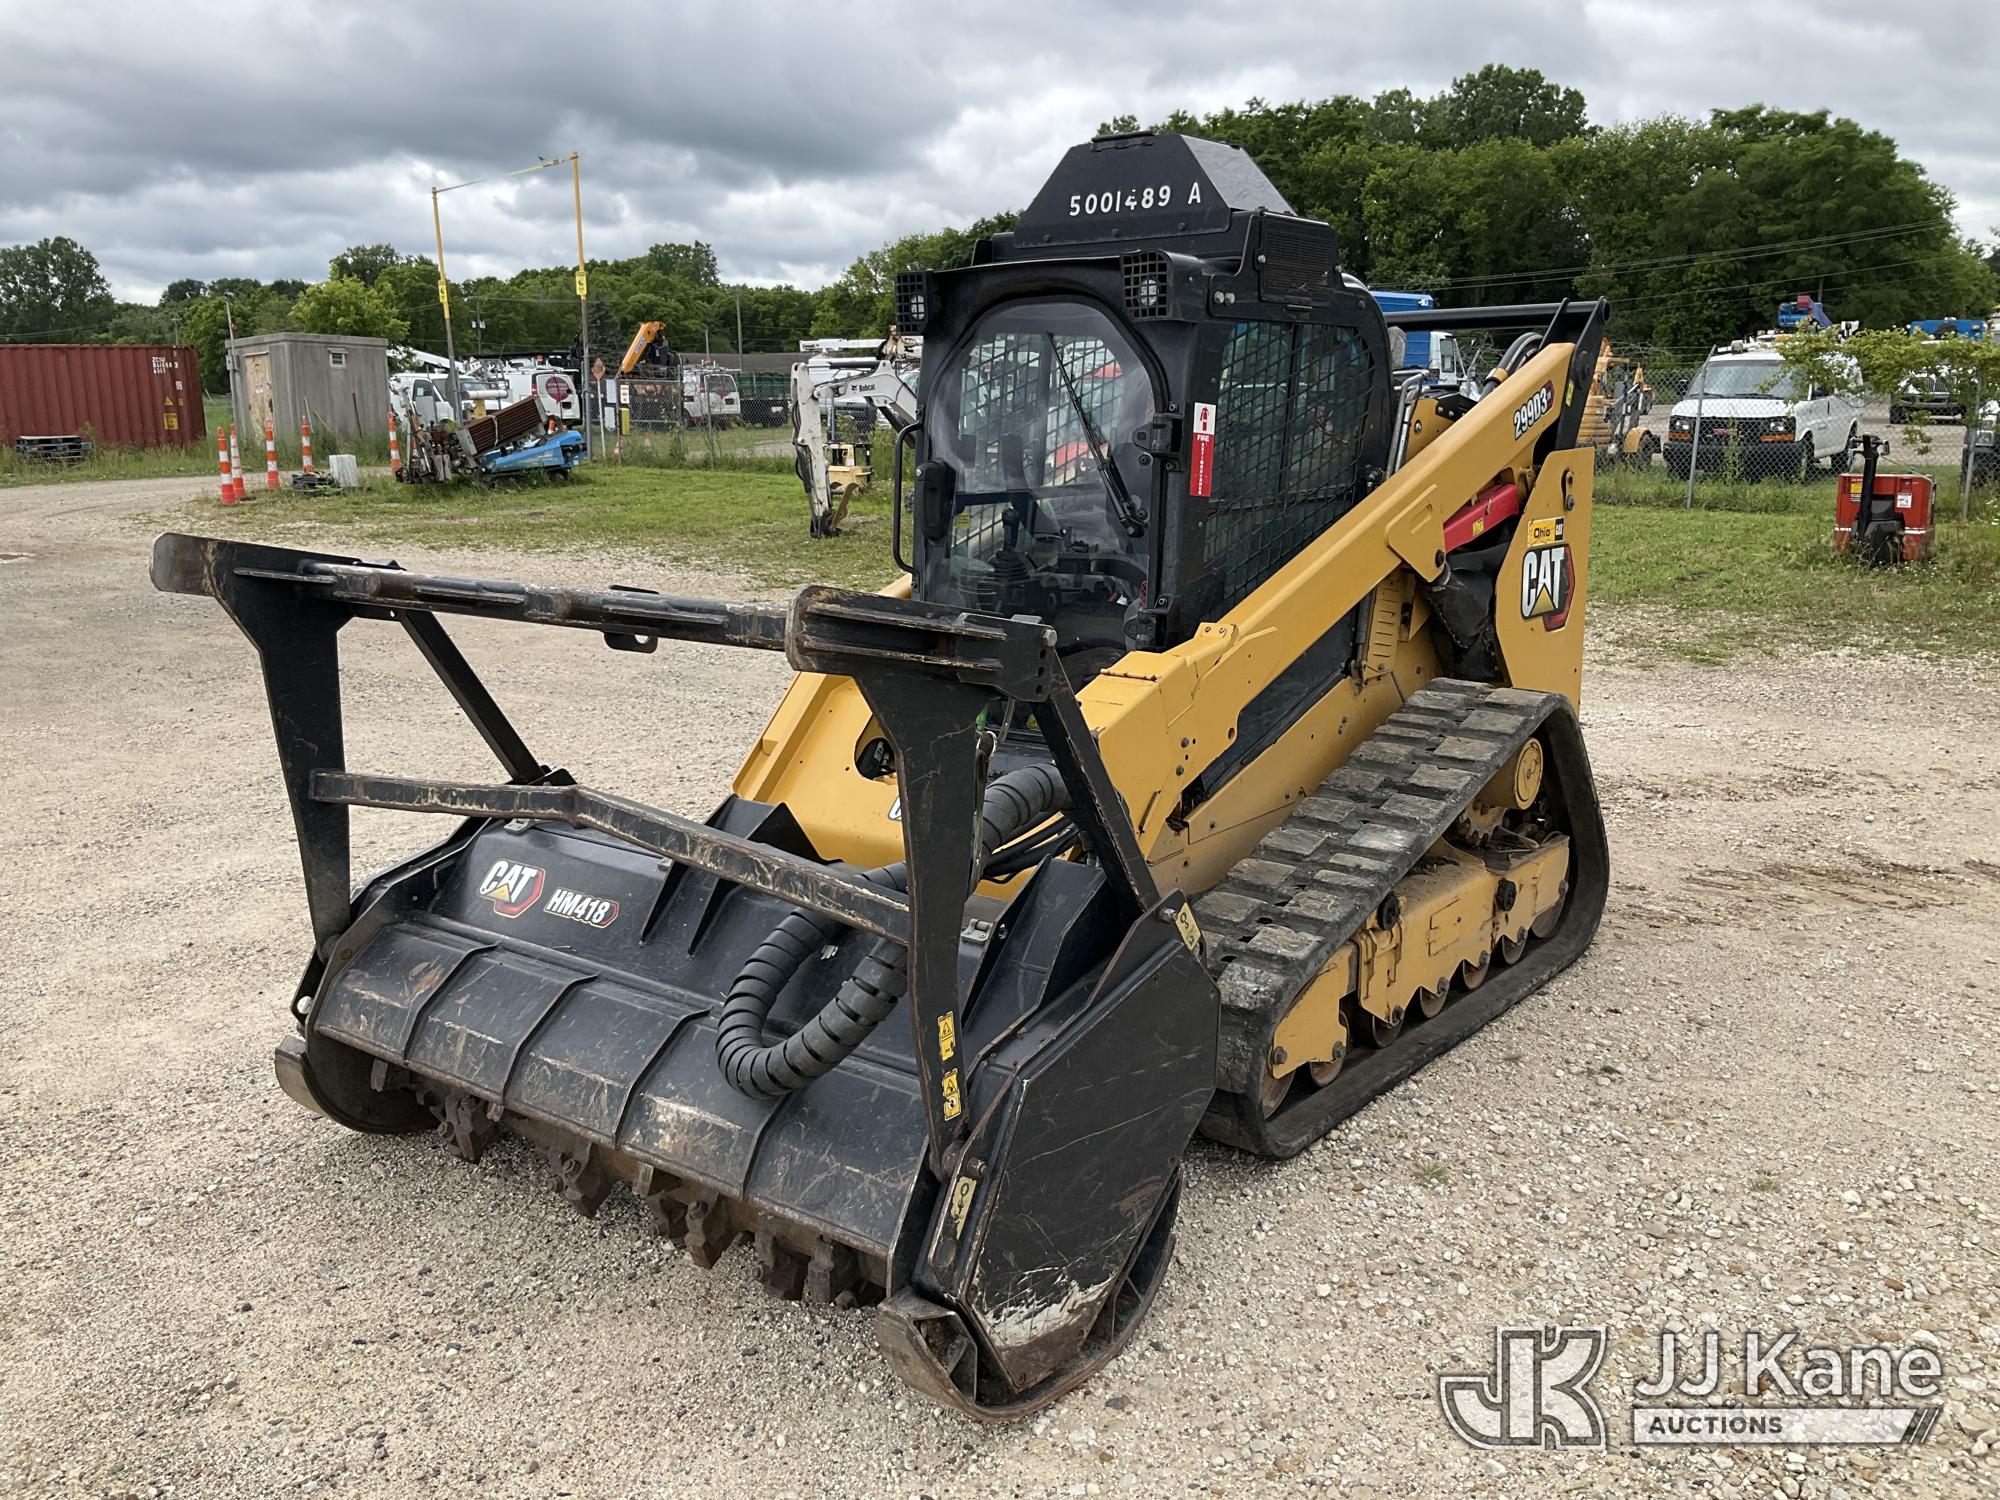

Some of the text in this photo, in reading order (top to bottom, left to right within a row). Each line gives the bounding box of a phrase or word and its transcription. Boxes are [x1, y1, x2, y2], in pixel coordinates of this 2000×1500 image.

[1069, 182, 1201, 217] 5001489 A
[1514, 387, 1548, 438] 299D3
[1197, 434, 1210, 442] FIRE
[1534, 527, 1550, 540] Ohio
[1523, 546, 1566, 618] CAT
[479, 860, 540, 903] CAT
[547, 888, 611, 924] HM418
